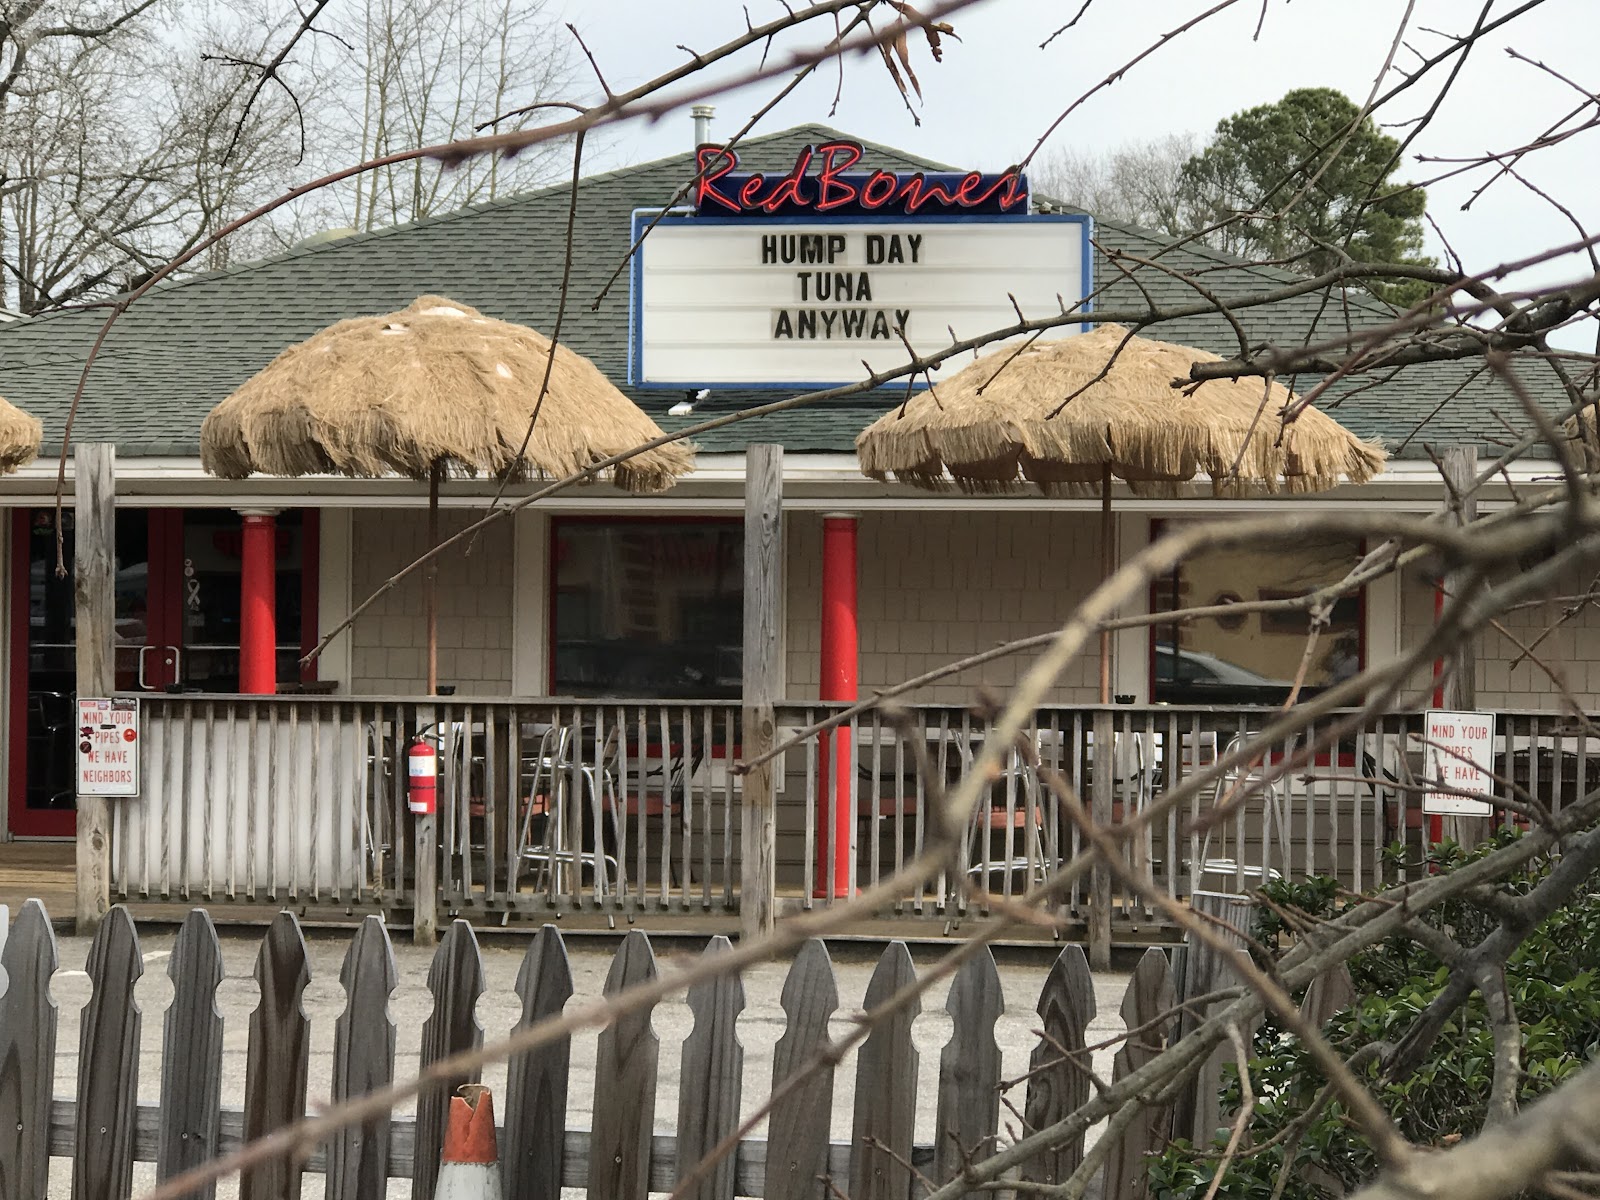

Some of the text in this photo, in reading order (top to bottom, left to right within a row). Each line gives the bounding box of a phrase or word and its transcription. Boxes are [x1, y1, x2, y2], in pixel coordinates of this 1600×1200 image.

[696, 140, 1028, 214] RedBones
[761, 234, 923, 264] HUMP DAY
[797, 271, 873, 302] TUNA
[774, 309, 910, 340] ANYWAY
[82, 712, 132, 724] MIND YOUR
[95, 731, 120, 743] PIPES
[1432, 725, 1488, 740] MIND YOUR
[88, 751, 128, 763] WE HAVE
[1444, 745, 1473, 760] PIPES
[83, 770, 132, 783] NEIGHBORS
[1455, 766, 1481, 781] HAVE
